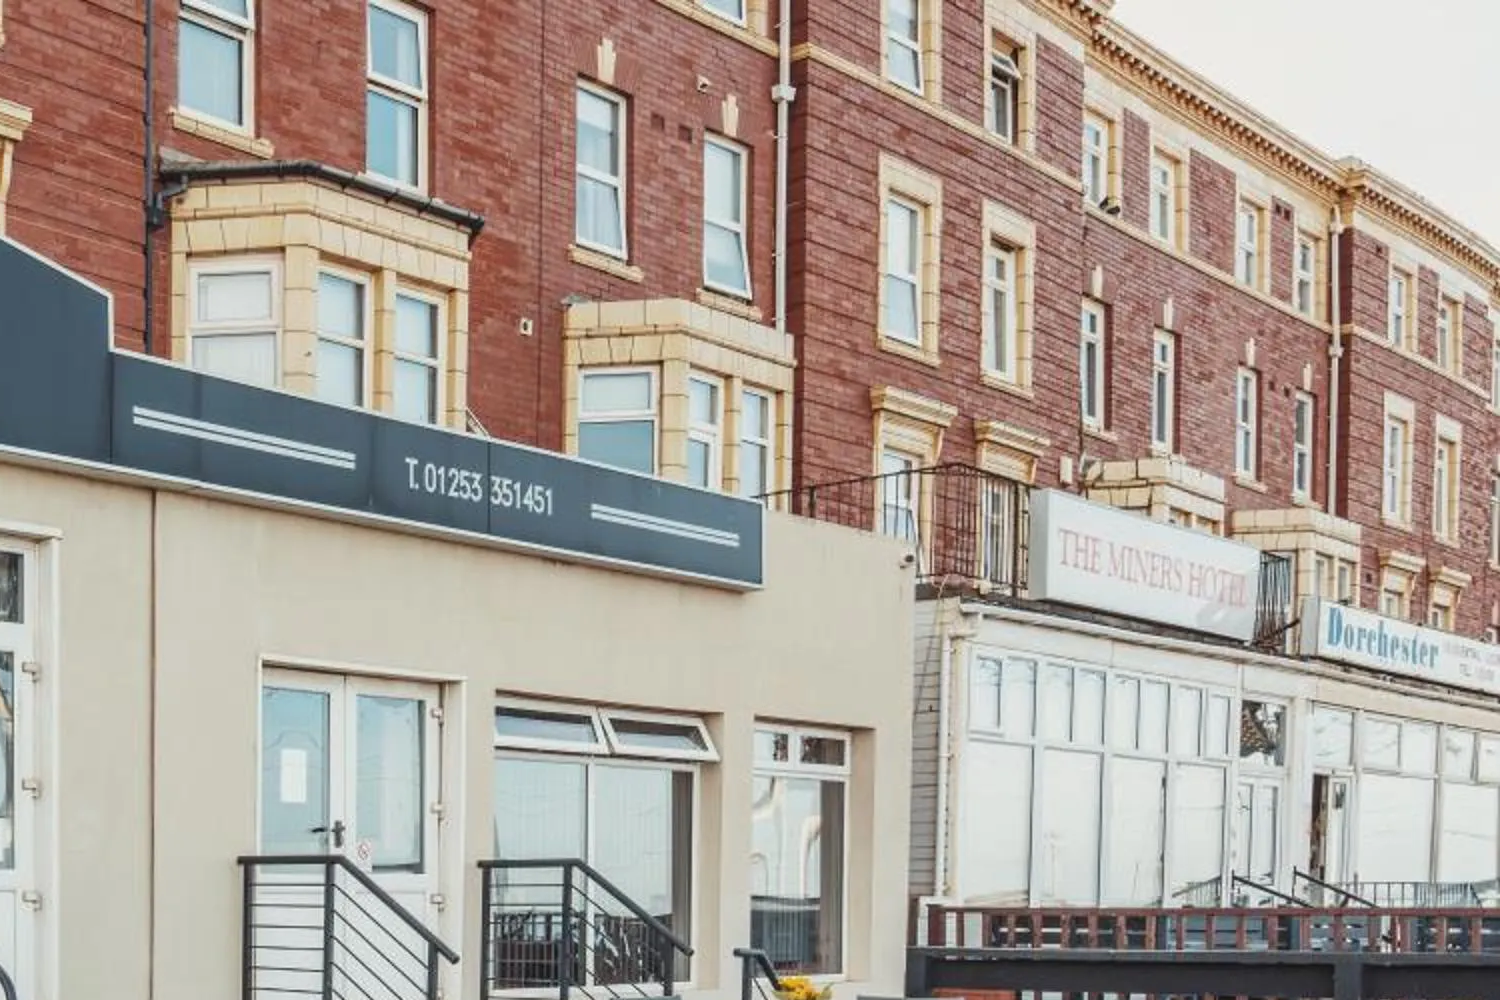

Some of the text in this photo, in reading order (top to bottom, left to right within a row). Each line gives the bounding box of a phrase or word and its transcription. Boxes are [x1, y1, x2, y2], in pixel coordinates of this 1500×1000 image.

[424, 463, 483, 503] 01253
[490, 475, 553, 516] 351451
[1058, 527, 1103, 575] THE
[1107, 541, 1183, 593] MINERS
[1327, 606, 1440, 670] Dorchester
